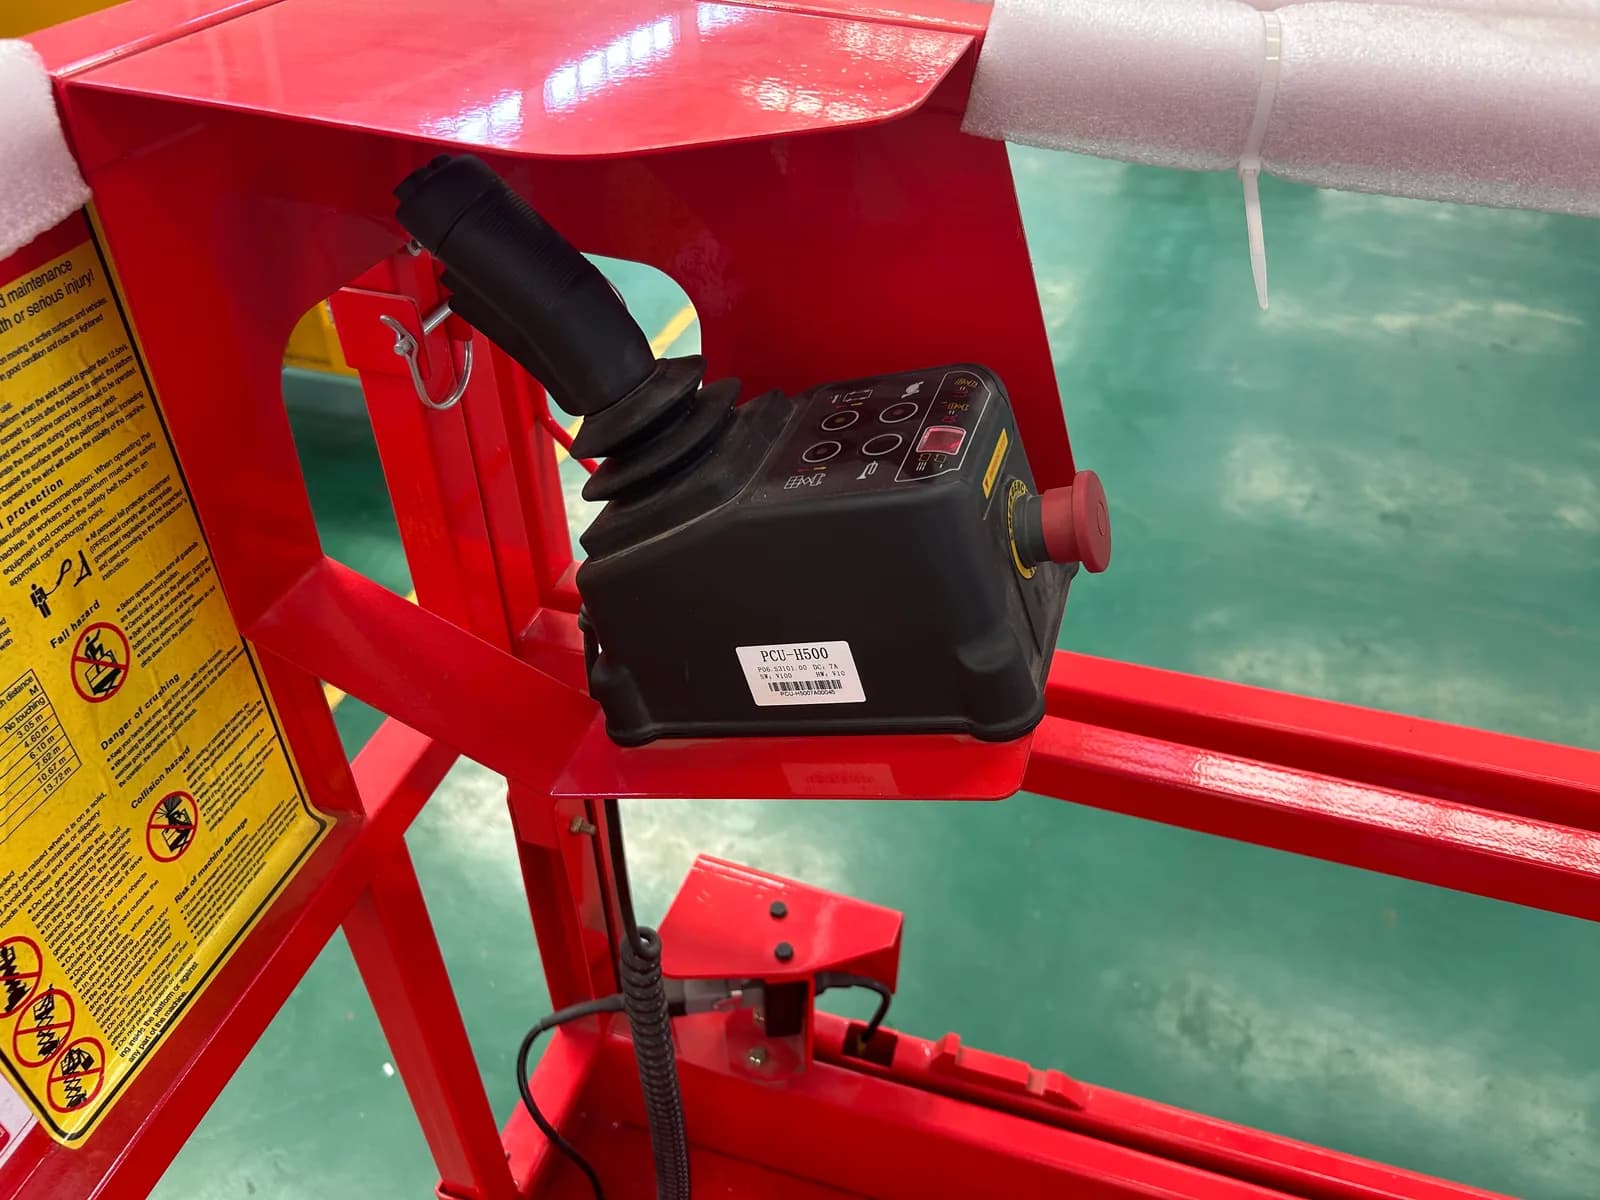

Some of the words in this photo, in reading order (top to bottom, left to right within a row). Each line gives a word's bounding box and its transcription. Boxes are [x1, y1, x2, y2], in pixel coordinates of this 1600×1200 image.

[0, 317, 13, 334] th
[13, 310, 25, 324] or
[26, 289, 64, 316] serious
[64, 270, 94, 294] injury!
[7, 261, 72, 303] maintenance
[0, 513, 39, 545] anufacturer
[94, 459, 113, 474] When
[113, 440, 141, 461] operating
[141, 432, 150, 441] the
[3, 544, 37, 575] equipment
[37, 533, 51, 548] and
[50, 514, 76, 536] connect
[75, 507, 86, 517] the
[87, 492, 105, 509] safety
[106, 482, 118, 494] belt
[118, 472, 133, 485] hook
[141, 461, 147, 469] an
[6, 480, 63, 525] protection
[26, 529, 35, 540] all
[35, 511, 62, 532] workers
[62, 504, 72, 513] on
[71, 496, 82, 506] the
[83, 477, 108, 499] platform
[108, 464, 123, 479] must
[124, 454, 137, 467] wear
[139, 443, 155, 456] safety
[9, 557, 40, 586] approved
[40, 546, 54, 561] rope
[54, 521, 87, 548] anchorage
[50, 628, 70, 648] Fall
[70, 600, 100, 631] hazard
[760, 647, 829, 662] PCU-H500
[2, 719, 16, 733] No
[15, 697, 45, 723] touching
[6, 676, 33, 701] distance
[29, 685, 39, 696] M
[101, 719, 131, 750] Danger
[134, 706, 143, 719] of
[145, 674, 179, 708] crushing
[16, 720, 34, 738] 3.05
[35, 714, 43, 722] m
[24, 731, 41, 748] 4.60
[41, 725, 49, 734] m
[29, 742, 46, 759] 6.10
[47, 735, 55, 744] m
[35, 752, 53, 770] 7.62
[52, 746, 60, 755] m
[37, 762, 56, 783] 10.67
[58, 756, 66, 765] m
[43, 772, 64, 794] 13.72
[63, 767, 71, 775] m
[131, 774, 164, 808] Collision
[165, 746, 190, 774] hazard
[4, 881, 18, 896] only
[18, 871, 28, 881] be
[28, 850, 48, 872] raised
[48, 833, 65, 851] when
[76, 813, 85, 822] on
[31, 899, 42, 910] Do
[42, 887, 54, 900] not
[54, 871, 68, 888] drive
[68, 862, 77, 871] on
[77, 844, 94, 863] roads
[94, 831, 106, 844] that
[44, 841, 70, 868] unstable
[70, 833, 77, 842] or
[77, 810, 100, 834] slippery
[174, 886, 190, 903] Risk
[190, 875, 197, 886] of
[198, 846, 224, 877] machine
[224, 818, 247, 846] damage
[18, 892, 33, 908] near
[33, 874, 51, 892] holes
[51, 859, 64, 874] and
[63, 843, 80, 861] steep
[32, 896, 55, 921] exceed
[65, 856, 93, 886] maximum
[93, 839, 109, 857] slope
[110, 826, 121, 840] and
[35, 896, 66, 928] inclination
[66, 870, 88, 896] allowed
[88, 863, 96, 872] by
[96, 853, 107, 863] the
[44, 922, 52, 930] In
[51, 911, 62, 923] the
[63, 890, 81, 911] raised
[97, 862, 107, 874] the
[108, 838, 130, 863] machine
[44, 919, 65, 942] cannot
[65, 903, 80, 919] drive
[80, 894, 89, 903] on
[89, 871, 110, 894] uneven
[48, 921, 74, 949] unstable
[74, 894, 98, 921] surfaces
[98, 886, 105, 894] or
[105, 870, 120, 886] other
[53, 932, 73, 956] gerous
[104, 887, 113, 899] nor
[114, 876, 125, 888] can
[129, 856, 142, 871] drive
[72, 965, 82, 976] Do
[83, 953, 93, 966] not
[93, 936, 108, 955] place
[108, 925, 118, 936] the
[117, 910, 130, 926] load
[130, 890, 149, 911] outside
[149, 880, 159, 890] the
[73, 961, 96, 988] platform
